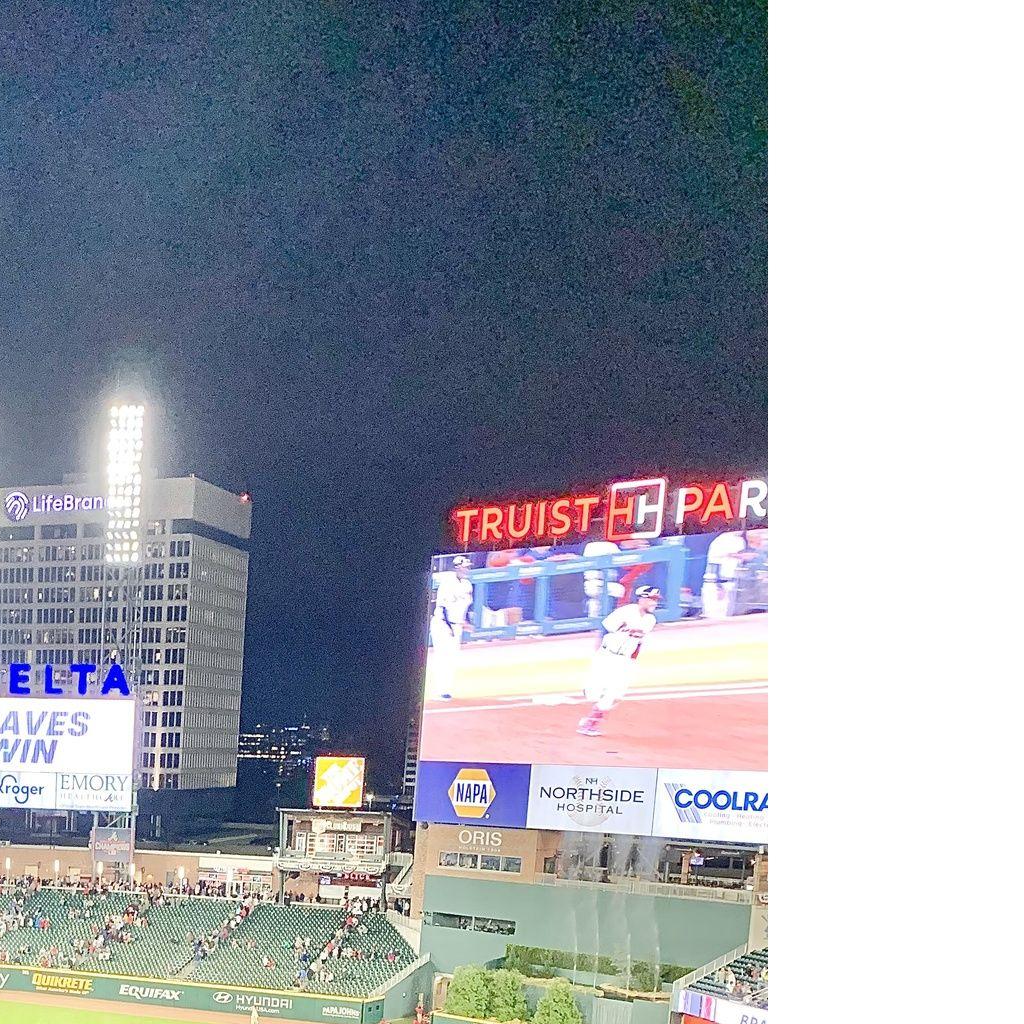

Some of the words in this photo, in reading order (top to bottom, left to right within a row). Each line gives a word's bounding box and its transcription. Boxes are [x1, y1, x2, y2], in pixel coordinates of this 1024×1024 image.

[32, 494, 109, 512] LifeBran
[456, 497, 599, 542] TRUIST
[60, 774, 128, 791] EMORY
[456, 782, 488, 804] NAPA
[539, 786, 645, 803] NORTHSIDE
[557, 803, 624, 815] HOSPITAL
[458, 829, 502, 847] ORIS
[32, 973, 94, 991] QUIKRETE
[119, 984, 182, 1001] EQUIFAX
[236, 994, 293, 1010] HYUNDAI
